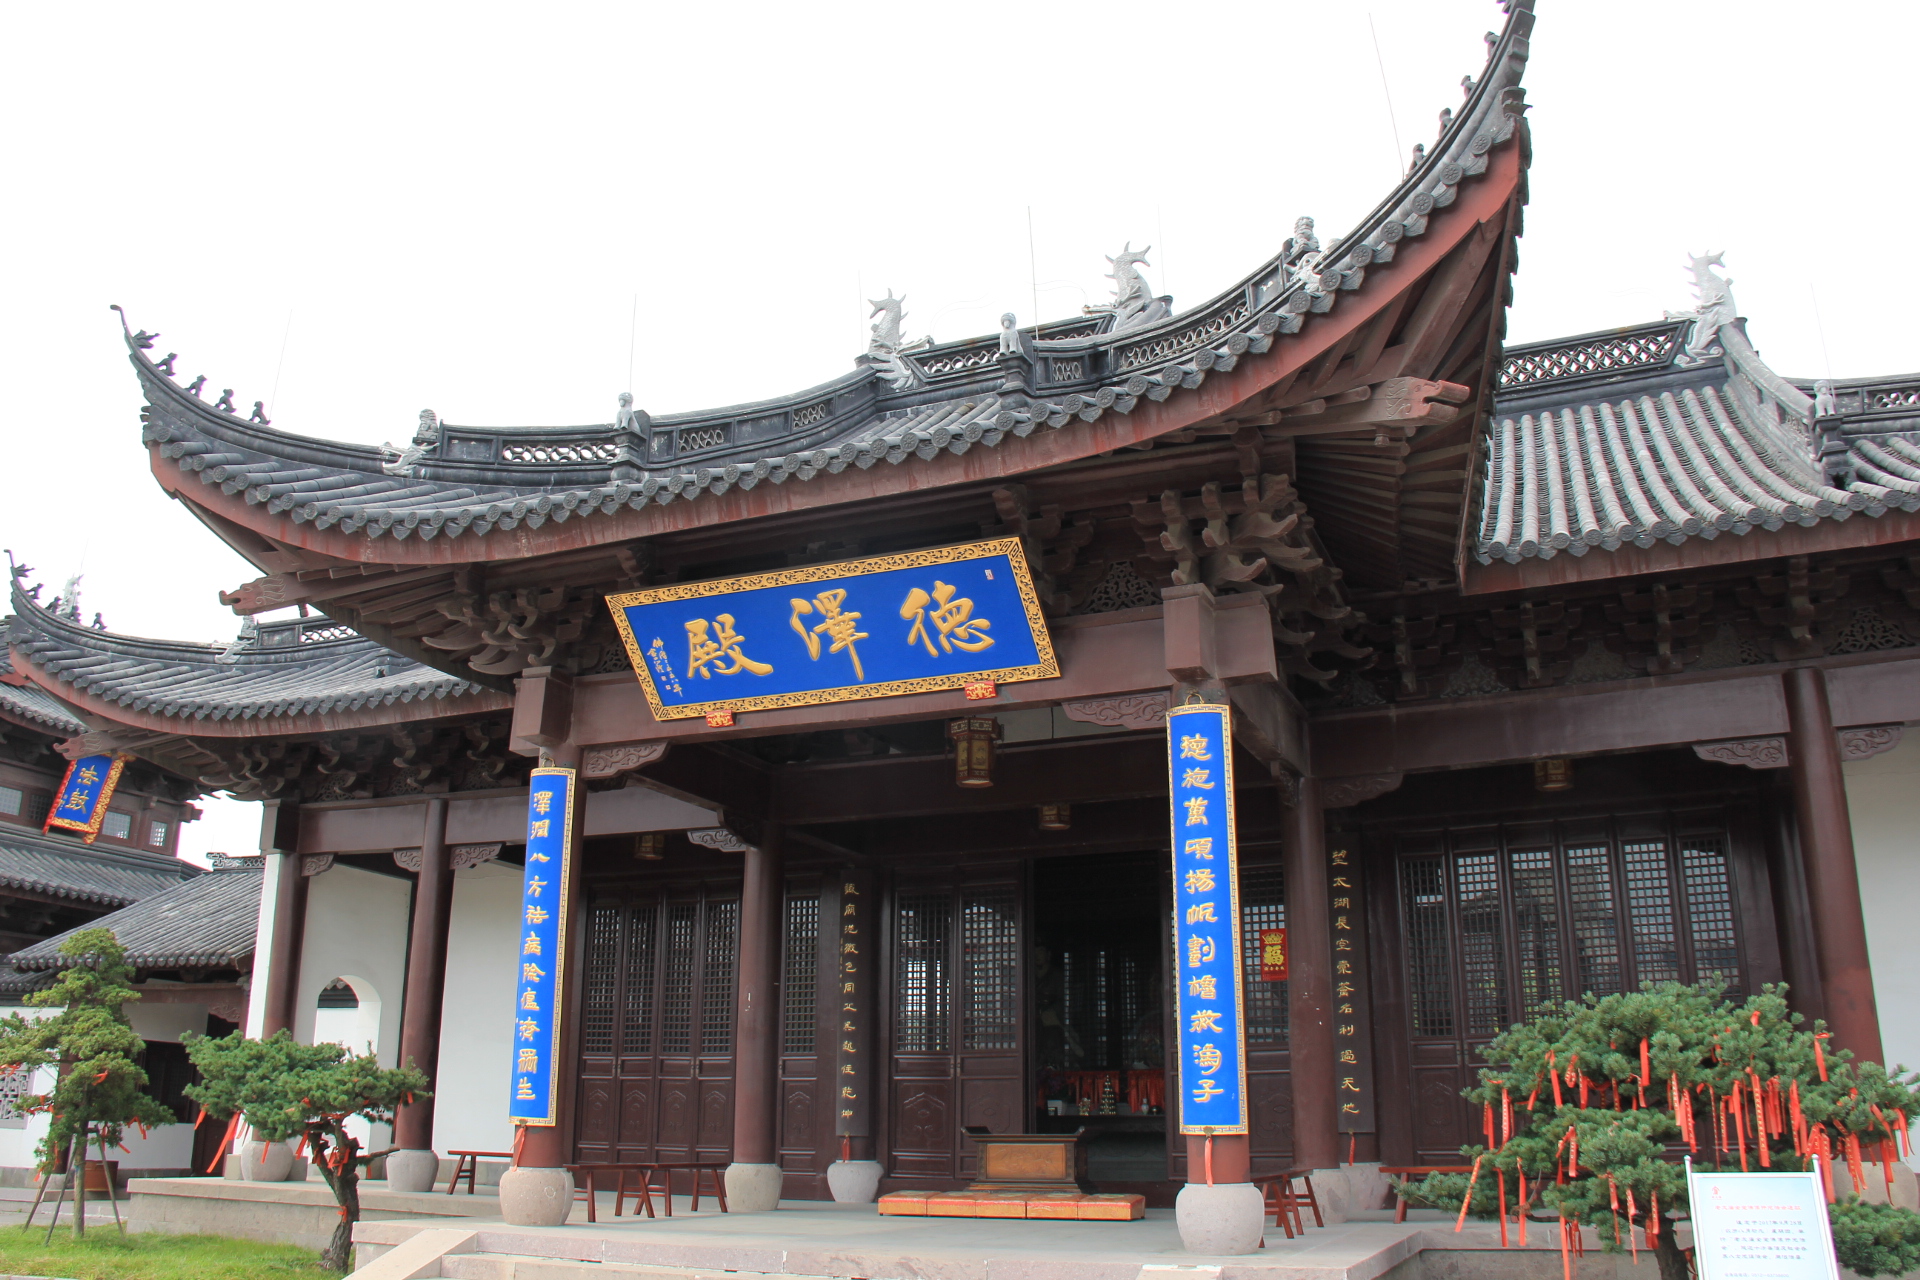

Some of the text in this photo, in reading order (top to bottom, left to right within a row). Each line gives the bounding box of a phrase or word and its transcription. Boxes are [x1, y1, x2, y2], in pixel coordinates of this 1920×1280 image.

[684, 580, 995, 682] 德澤殿
[64, 765, 99, 814] 法鼓
[1264, 945, 1284, 966] 福
